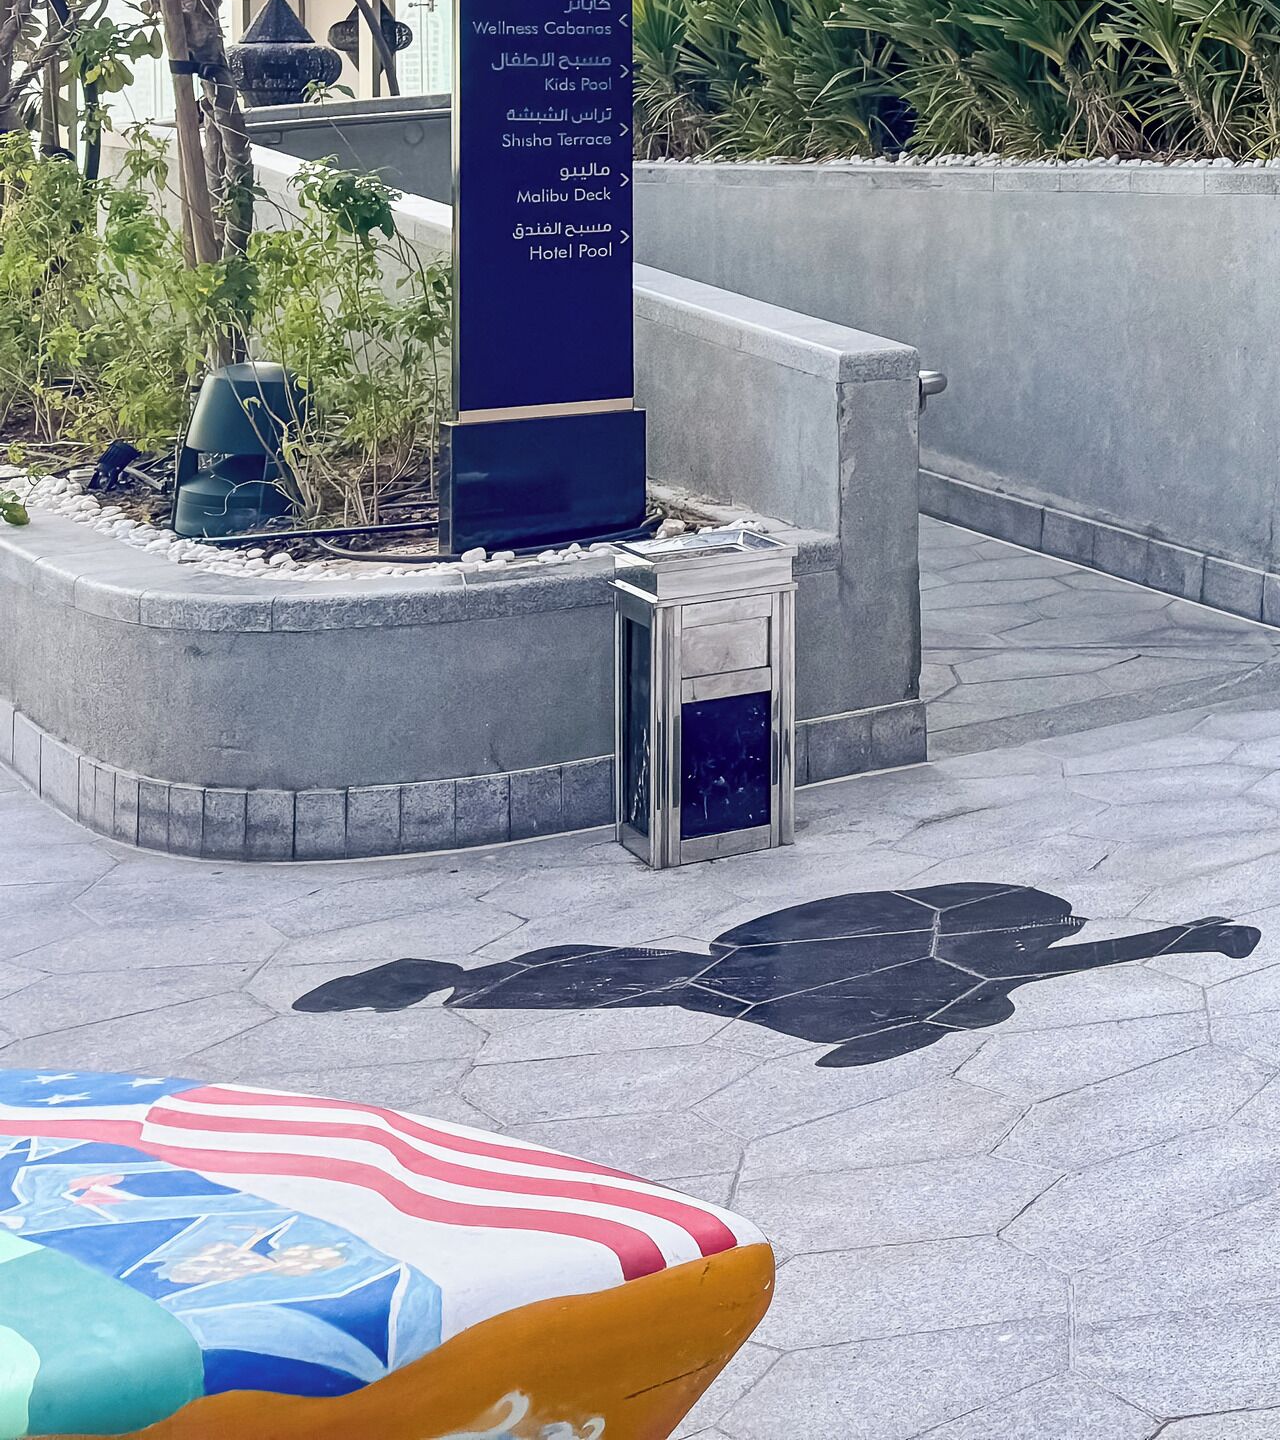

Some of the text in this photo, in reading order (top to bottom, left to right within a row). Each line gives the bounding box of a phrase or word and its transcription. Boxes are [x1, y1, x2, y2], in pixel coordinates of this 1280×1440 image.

[472, 20, 613, 35] Wellness Cabanas
[558, 54, 612, 71] مسبح
[545, 76, 613, 92] Kids Pool
[502, 132, 613, 148] Shisha Terrace
[559, 162, 611, 181] ماليبو
[516, 186, 612, 203] Malibu Deck
[512, 221, 612, 240] مسبح الفندق
[529, 241, 613, 261] Hotel Pool
